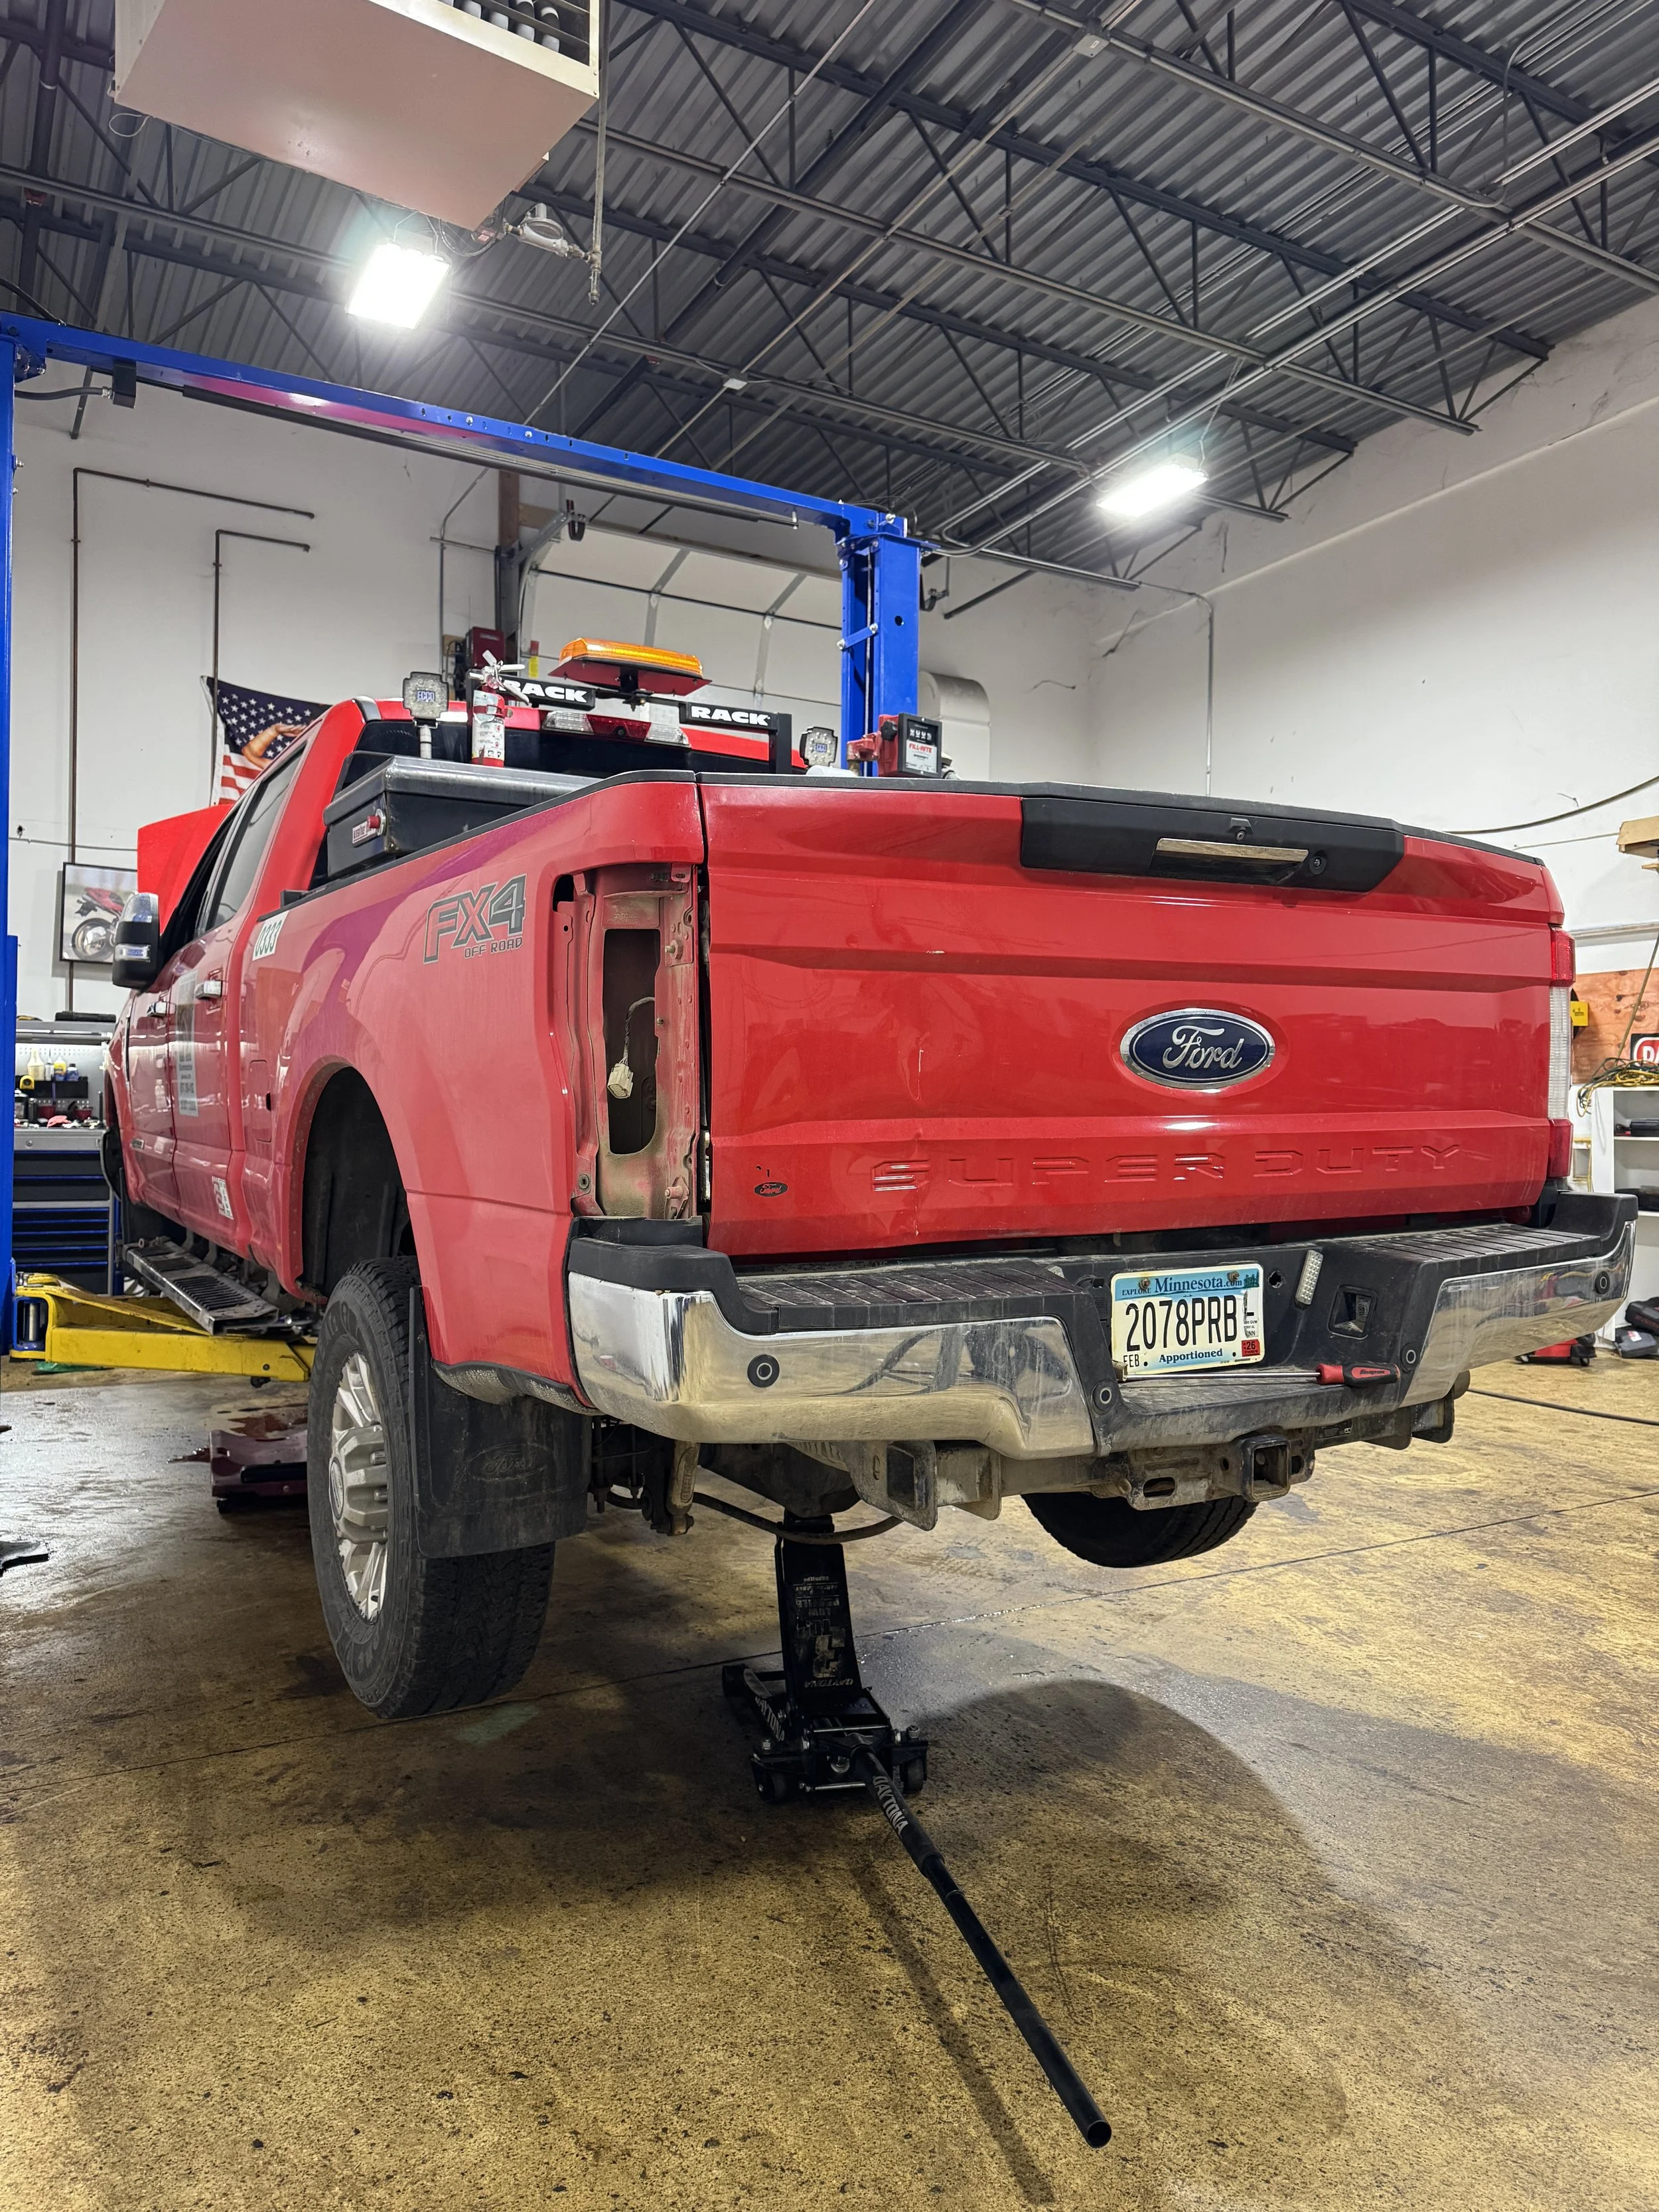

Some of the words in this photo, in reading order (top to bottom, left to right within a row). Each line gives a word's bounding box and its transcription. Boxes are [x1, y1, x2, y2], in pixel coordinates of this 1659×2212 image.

[691, 705, 768, 726] RACK
[423, 873, 527, 964] FX4
[254, 920, 283, 957] 0333
[464, 944, 486, 959] OFF
[490, 936, 523, 954] ROAD
[1163, 1025, 1245, 1069] Ford
[871, 1153, 1225, 1191] SUPER
[1253, 1144, 1459, 1177] DUTY
[760, 1183, 782, 1194] Ford
[1125, 1295, 1237, 1352] 2078PRB
[1159, 1348, 1223, 1363] Apportioned
[1247, 1341, 1256, 1350] 26
[804, 1679, 855, 1691] DAYTONA
[873, 1775, 908, 1836] DAYTONA
